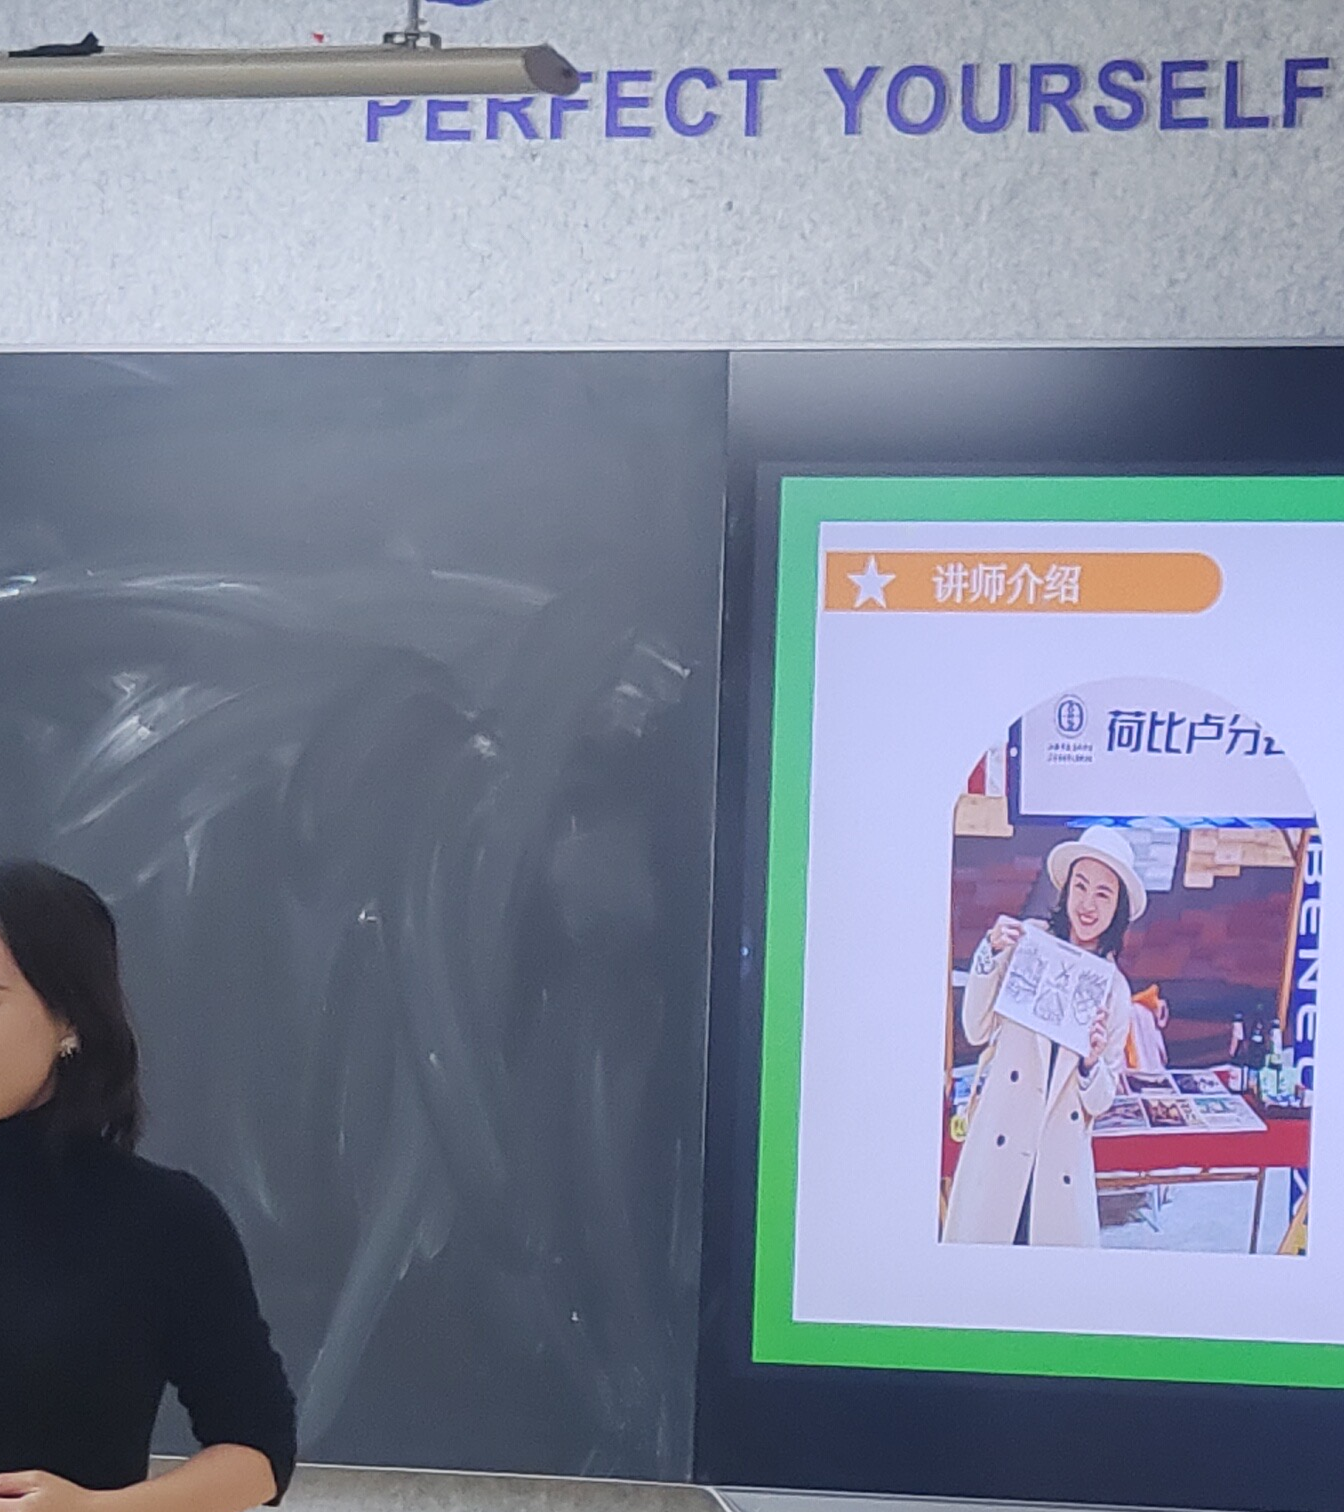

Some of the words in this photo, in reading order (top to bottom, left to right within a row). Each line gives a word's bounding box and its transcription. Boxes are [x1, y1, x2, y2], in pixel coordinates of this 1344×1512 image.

[366, 68, 777, 142] PERFECT
[824, 57, 1330, 136] YOURSELF
[932, 563, 1081, 604] 讲师介绍
